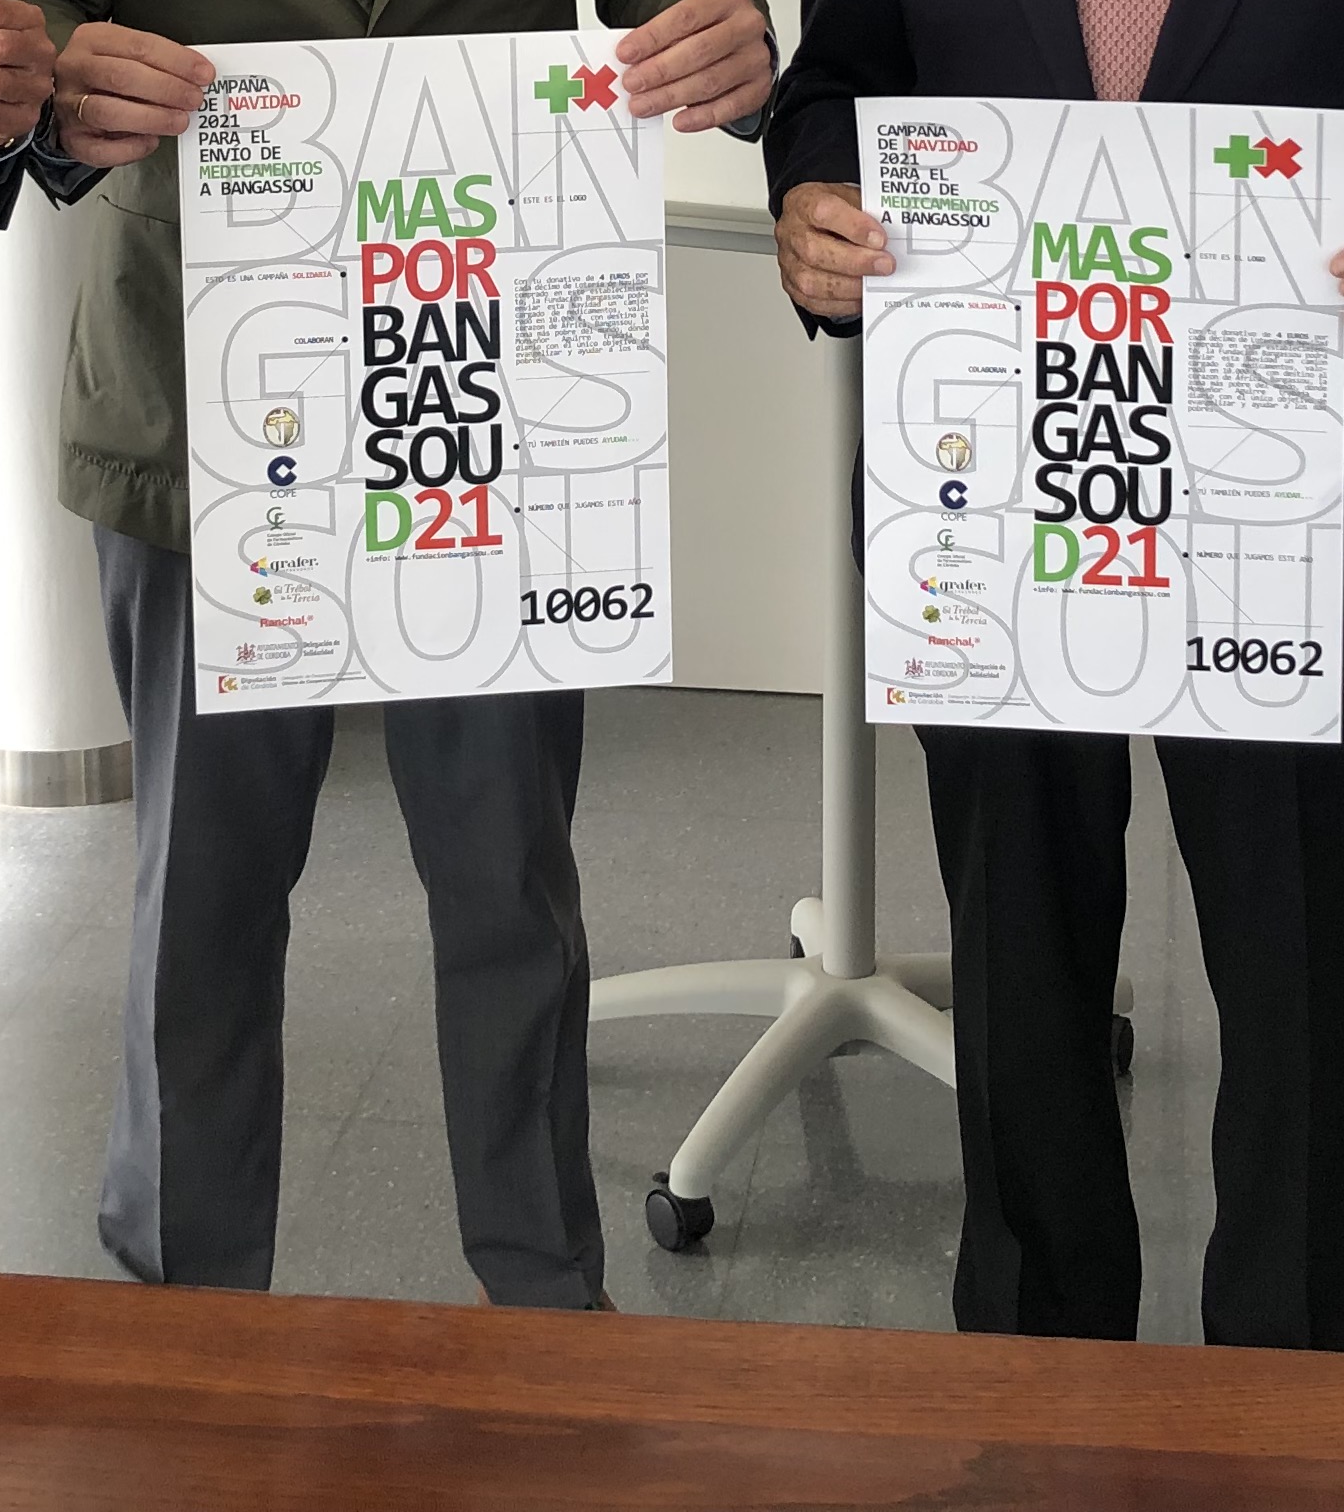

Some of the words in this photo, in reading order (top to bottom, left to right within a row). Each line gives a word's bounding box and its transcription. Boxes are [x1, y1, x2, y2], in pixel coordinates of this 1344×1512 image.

[227, 94, 301, 110] NAVIDAD
[198, 113, 240, 128] 2021
[877, 121, 947, 137] CAMPAÑA
[198, 130, 240, 145] PARA
[250, 129, 270, 143] EL
[878, 137, 897, 149] DE
[907, 138, 978, 152] NAVIDAD
[199, 143, 251, 162] ENVÍO
[260, 145, 281, 159] DE
[879, 152, 919, 164] 2021
[199, 161, 323, 180] MEDICAMENTOS
[880, 166, 919, 179] PARA
[929, 168, 948, 180] EL
[199, 182, 211, 196] A
[221, 178, 313, 195] BANGASSOU
[880, 178, 930, 194] ENVÍO
[939, 183, 958, 195] DE
[355, 173, 497, 242] MAS
[880, 196, 999, 212] MEDICAMENTOS
[880, 211, 891, 223] A
[901, 212, 990, 227] BANGASSOU
[1031, 220, 1172, 284] MAS
[361, 236, 500, 304] POR
[1036, 279, 1174, 344] POR
[294, 336, 333, 344] COLABORAN
[363, 299, 501, 366] BAN
[968, 365, 1007, 373] COLABORAN
[1036, 340, 1173, 404] BAN
[360, 360, 501, 429] GAS
[1032, 400, 1172, 466] GAS
[364, 422, 503, 491] SOU
[270, 488, 296, 498] COPE
[1034, 461, 1172, 526] SOU
[364, 484, 503, 553] D21
[941, 512, 966, 521] COPE
[1033, 523, 1170, 588] D21
[520, 582, 654, 625] 10062
[1187, 635, 1324, 677] 10062
